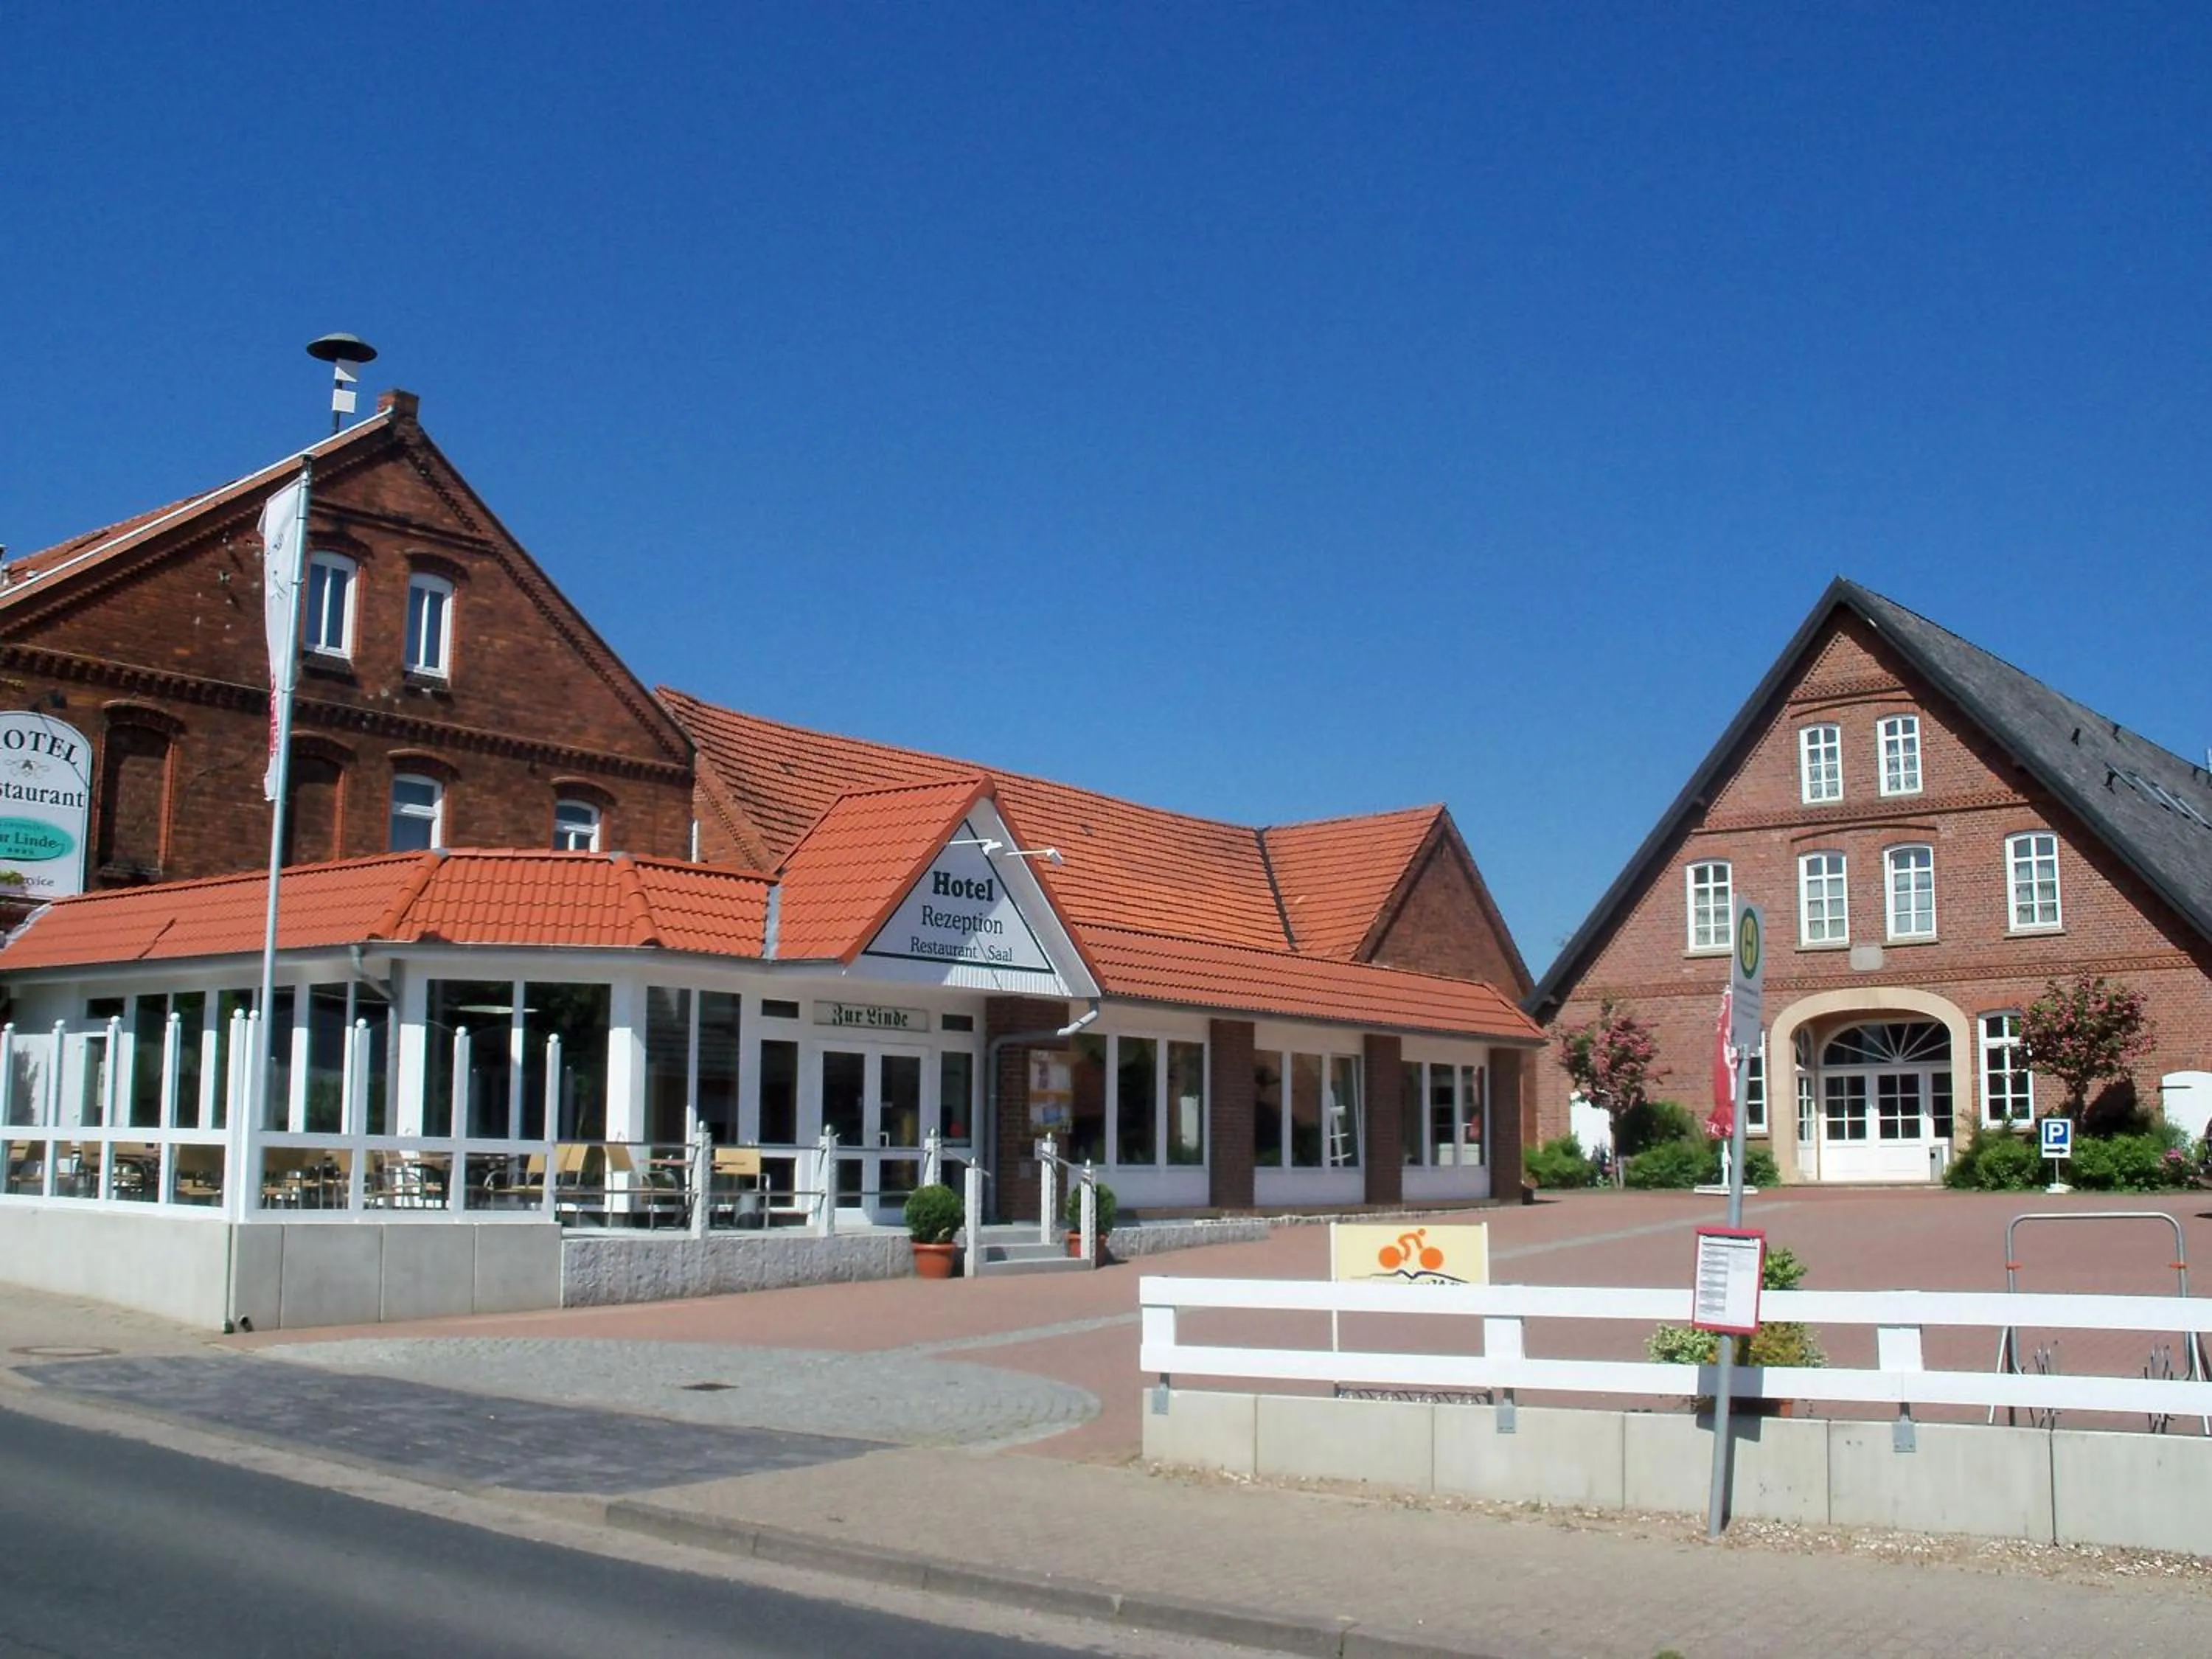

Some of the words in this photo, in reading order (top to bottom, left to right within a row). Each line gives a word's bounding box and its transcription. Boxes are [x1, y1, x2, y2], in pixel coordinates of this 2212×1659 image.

[0, 728, 77, 765] OTEL
[15, 831, 59, 849] Linde
[932, 870, 995, 901] Hotel
[922, 905, 1004, 936] Rezeption
[910, 936, 978, 959] Restaurant
[988, 945, 1013, 962] Saal
[1745, 922, 1756, 964] H
[832, 1004, 863, 1026] Zur
[867, 1007, 908, 1026] Linde
[2048, 1123, 2065, 1143] P
